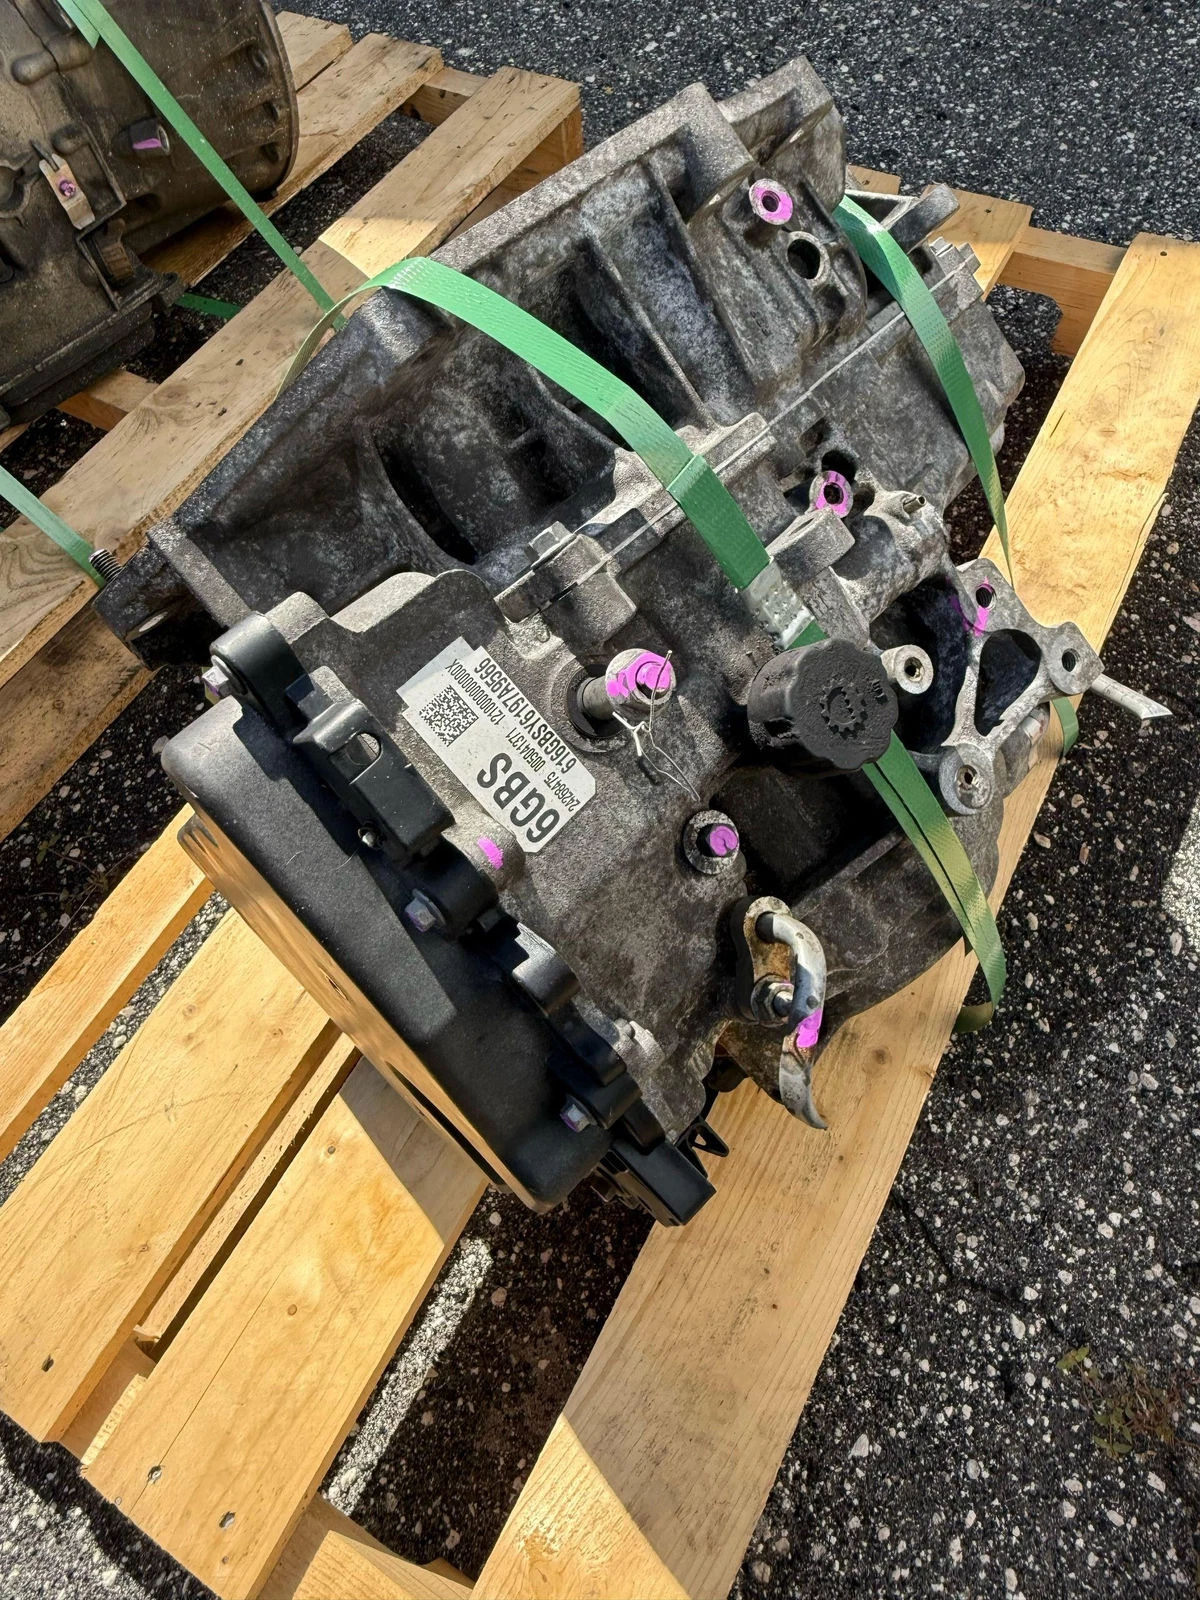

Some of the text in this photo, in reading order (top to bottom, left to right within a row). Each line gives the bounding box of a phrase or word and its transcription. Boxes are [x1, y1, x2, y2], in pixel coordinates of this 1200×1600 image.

[444, 658, 581, 812] 24268475 005041371 1210000000000X
[474, 657, 577, 774] 616GBSY6197A9566
[476, 752, 560, 843] 6GBS
